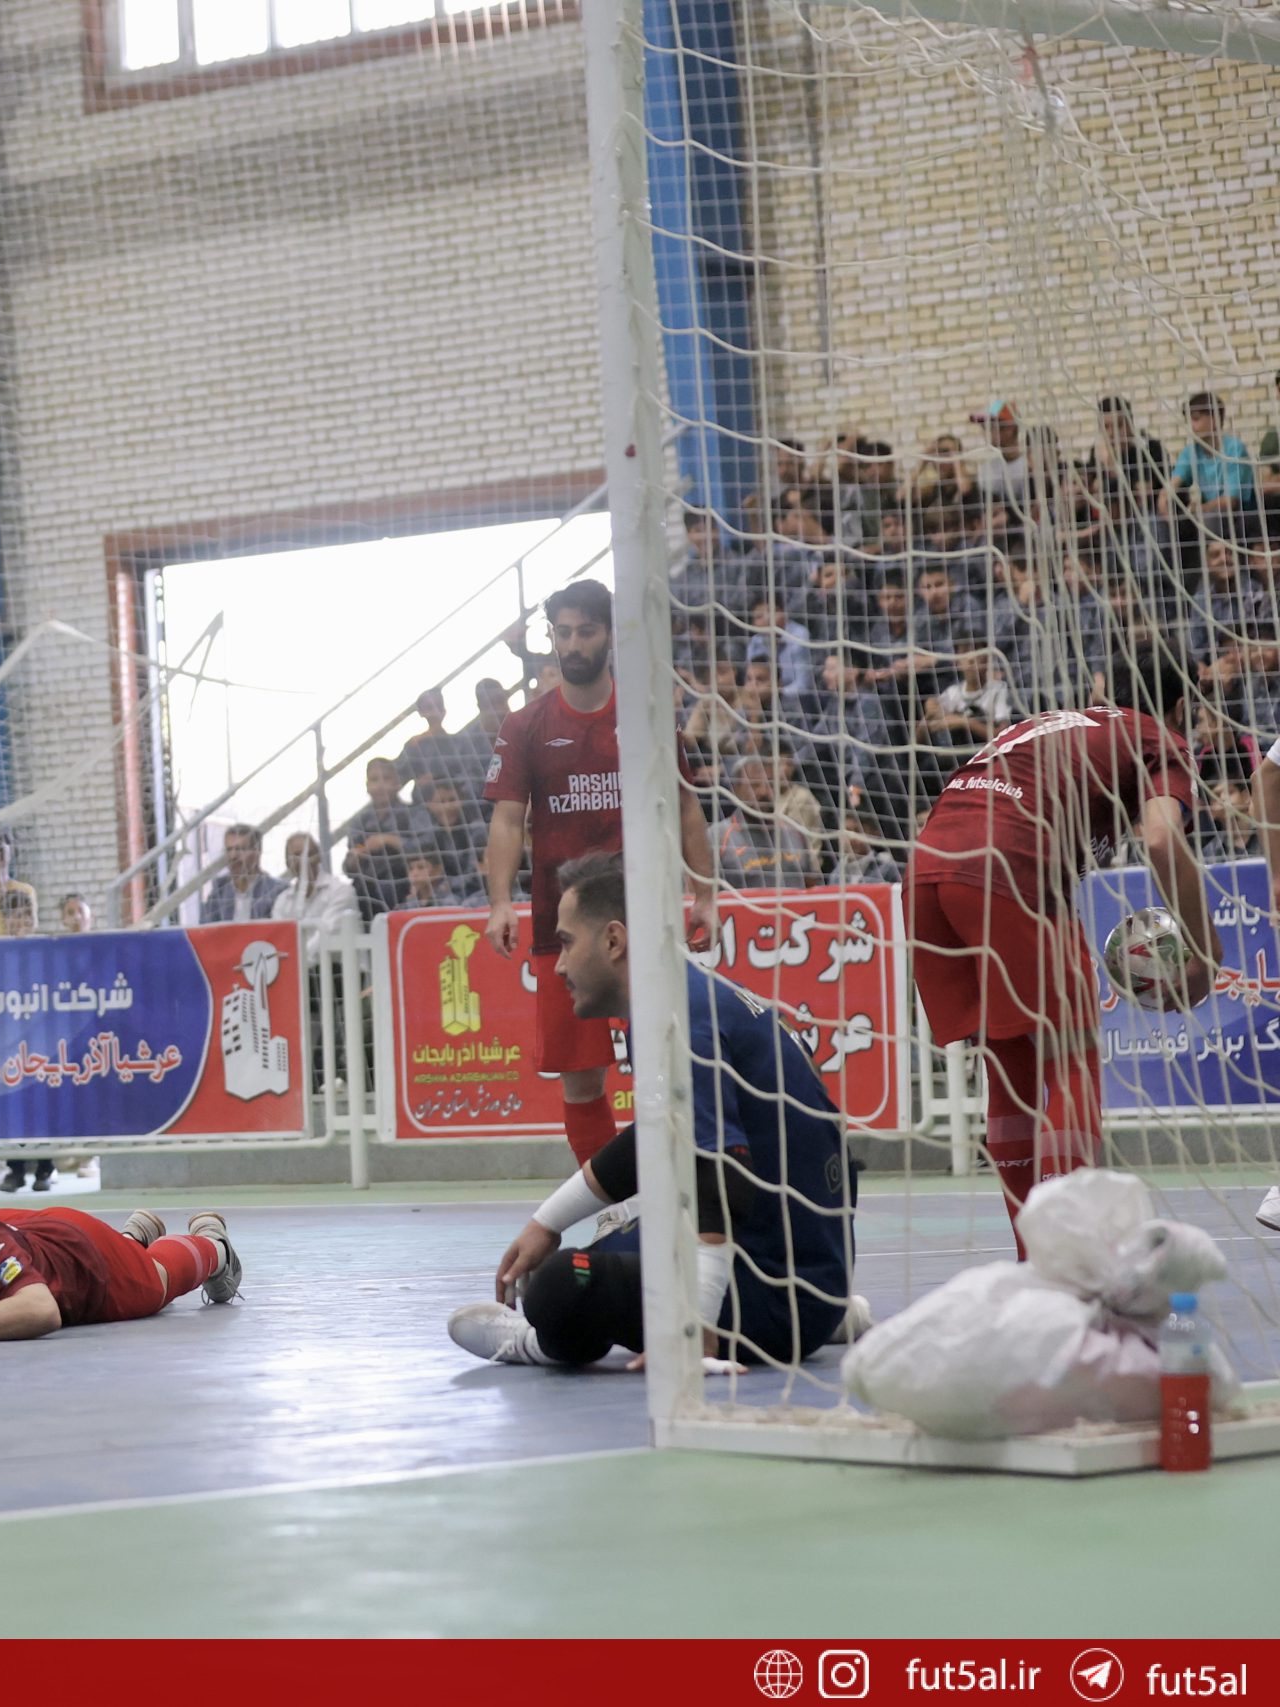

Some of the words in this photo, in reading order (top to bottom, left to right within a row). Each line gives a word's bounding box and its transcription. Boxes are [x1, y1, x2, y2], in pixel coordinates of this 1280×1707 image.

[549, 791, 623, 813] AZARBAI
[52, 972, 134, 1017] شرکت
[2, 1031, 115, 1088] آذربایجان
[111, 1036, 183, 1083] عرشیا
